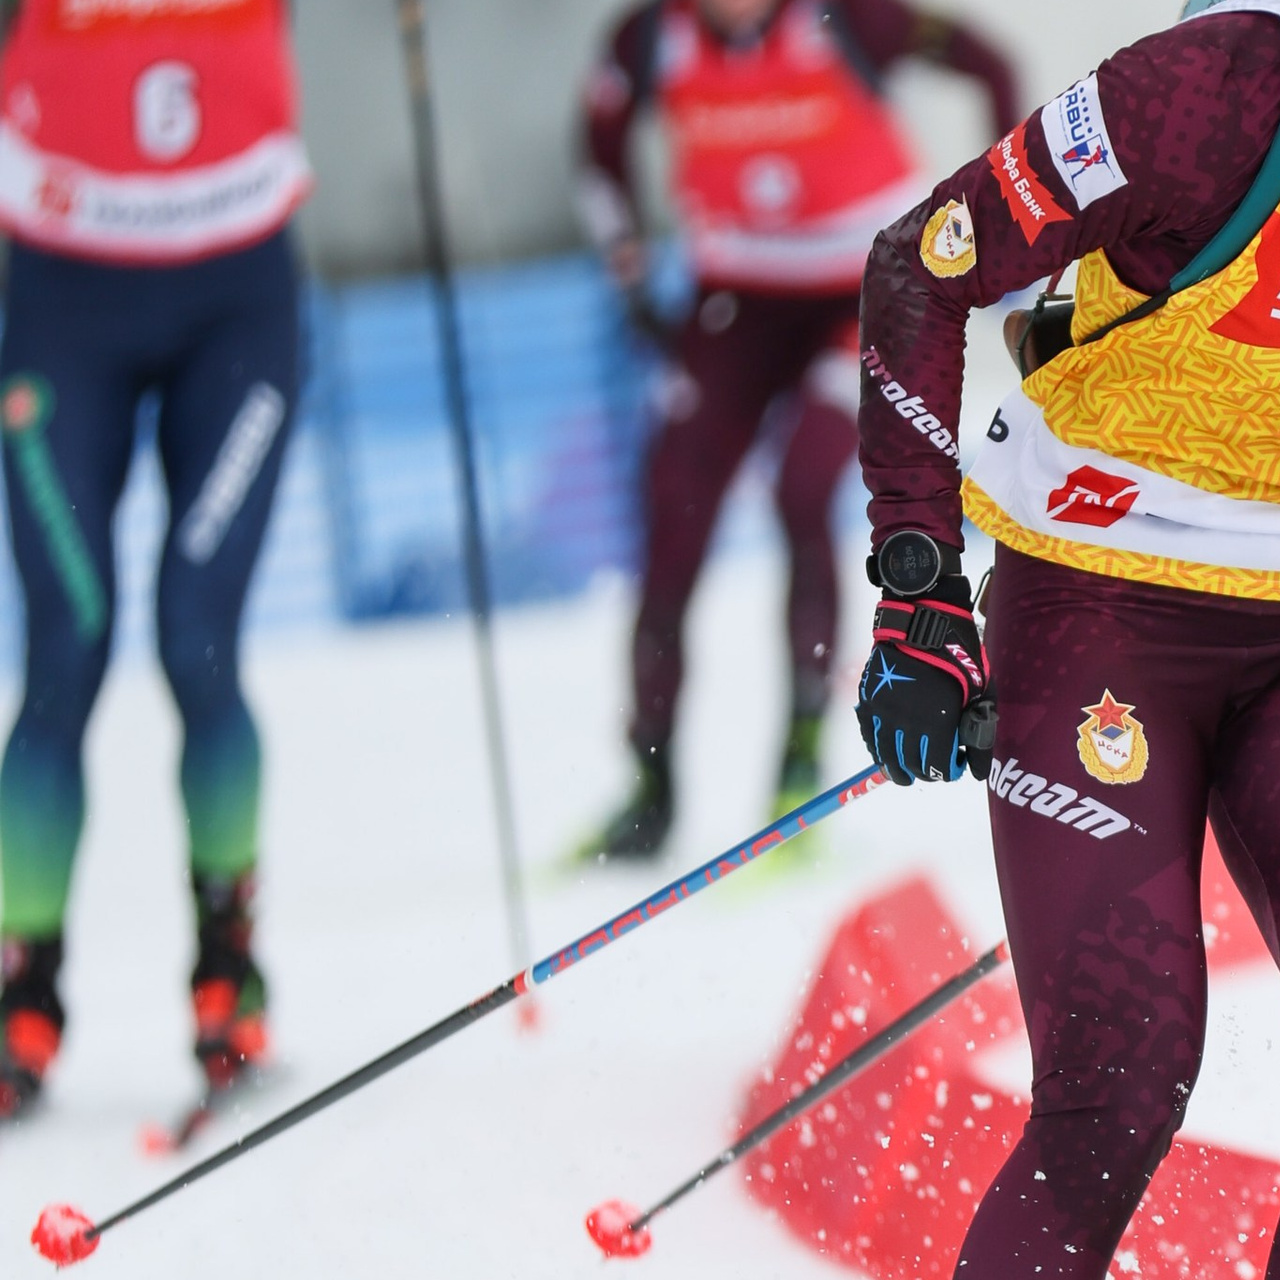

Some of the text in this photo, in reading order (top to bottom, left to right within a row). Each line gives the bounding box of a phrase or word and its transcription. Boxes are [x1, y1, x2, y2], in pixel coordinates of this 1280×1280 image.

[133, 59, 200, 162] 6
[1065, 92, 1086, 142] RBU
[1014, 178, 1046, 220] Банк
[945, 643, 983, 687] KV+
[1097, 740, 1128, 759] ЦСКА
